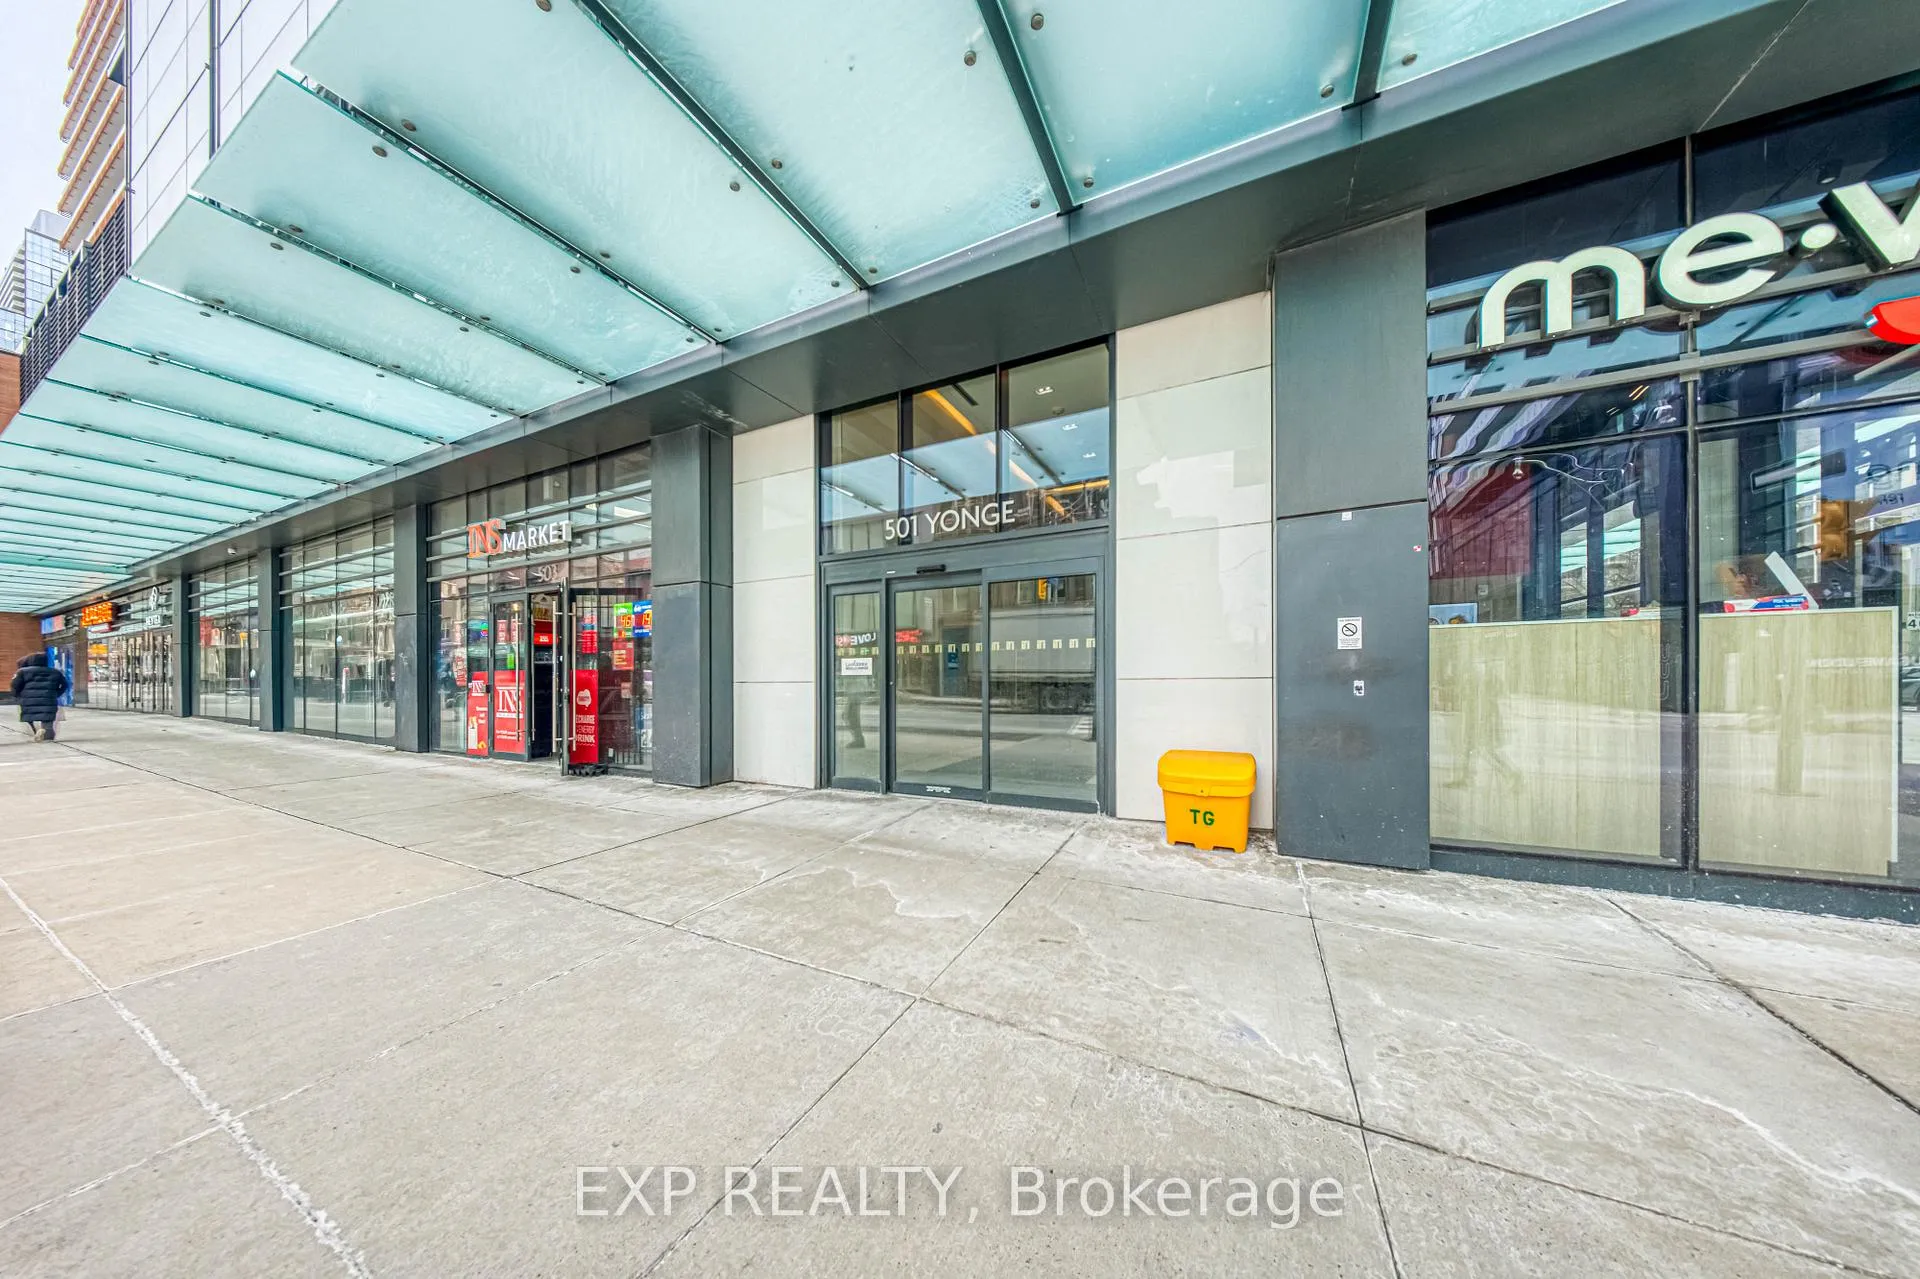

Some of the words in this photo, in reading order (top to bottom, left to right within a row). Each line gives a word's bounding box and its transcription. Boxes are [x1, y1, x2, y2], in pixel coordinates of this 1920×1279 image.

[885, 515, 918, 540] 501
[925, 500, 1015, 534] YONGE
[467, 519, 502, 558] INS
[503, 520, 570, 552] MARKET
[538, 564, 558, 582] 503
[1908, 619, 1920, 628] 4
[576, 715, 595, 724] ECHARGE
[1190, 809, 1215, 826] TG
